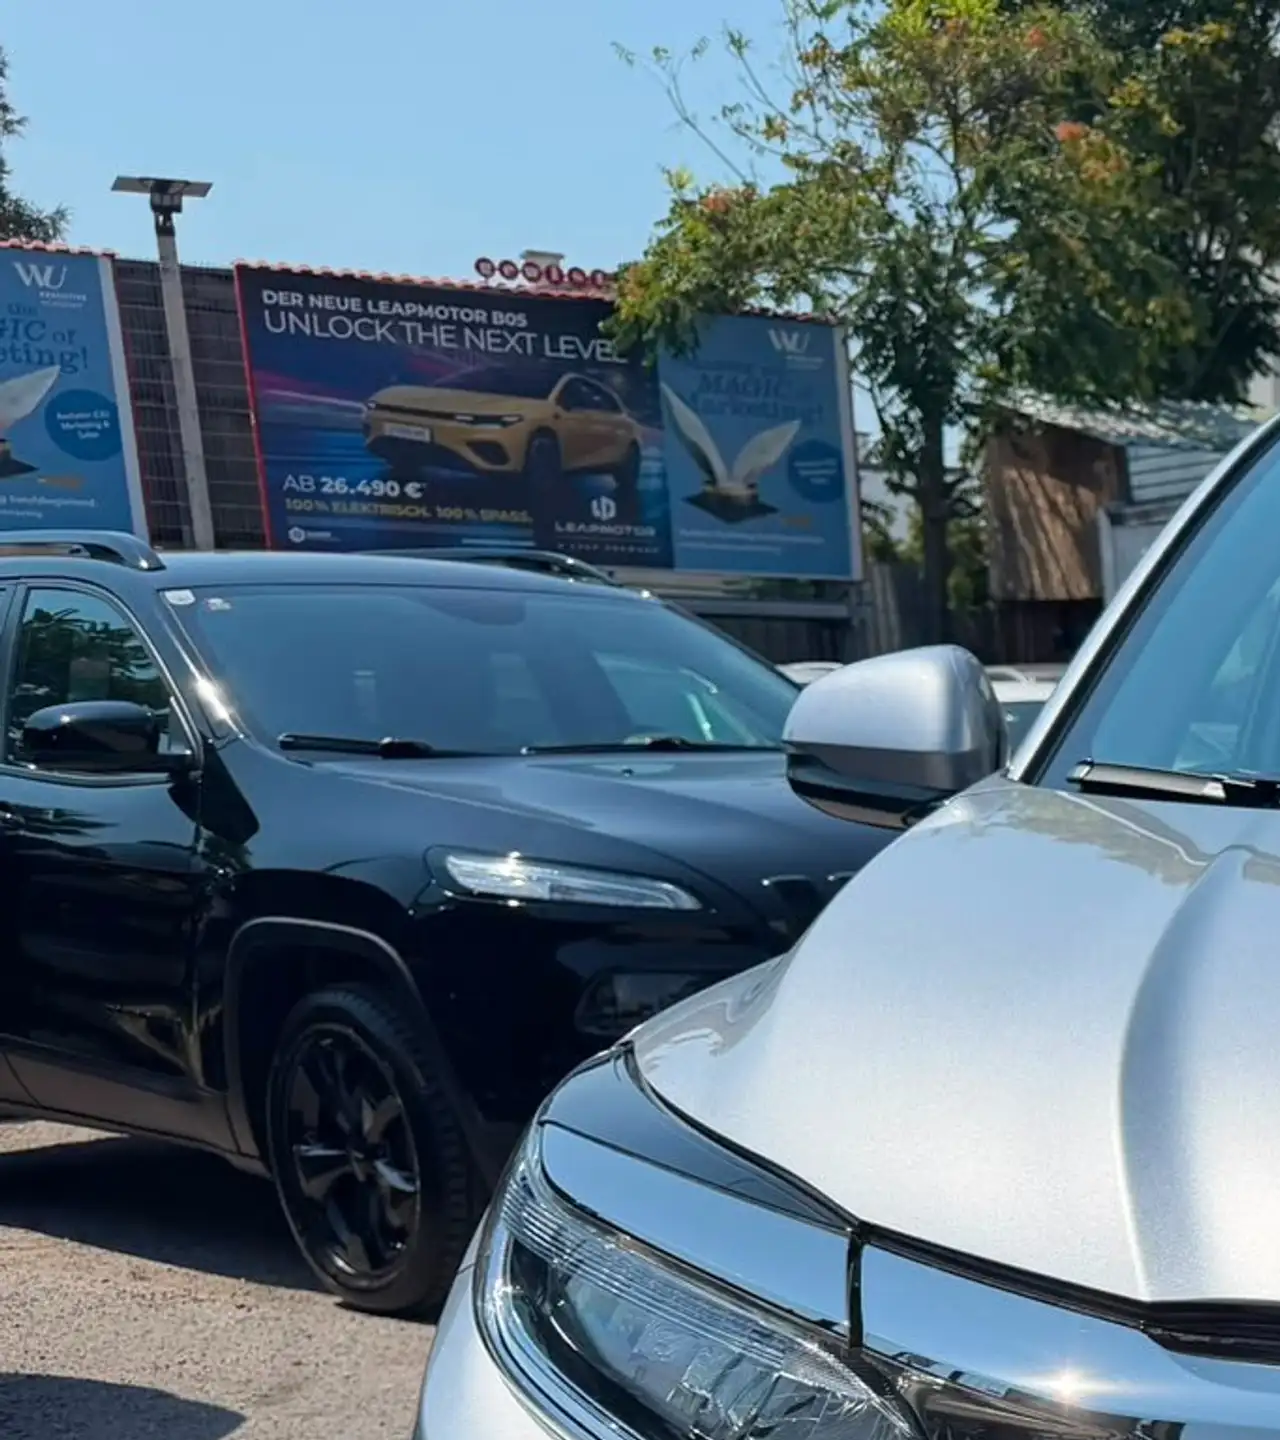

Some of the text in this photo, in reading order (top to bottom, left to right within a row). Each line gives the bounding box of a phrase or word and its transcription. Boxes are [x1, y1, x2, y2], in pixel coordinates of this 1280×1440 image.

[13, 261, 68, 289] WU
[261, 288, 303, 309] DER
[308, 293, 363, 313] NEUE
[367, 298, 488, 325] LEAPMOTOR
[264, 308, 629, 364] UNLOCK THE NEXT LEVEL
[282, 474, 316, 493] AB
[320, 477, 400, 498] 26.490
[555, 521, 656, 537] LEAPMOTOR
